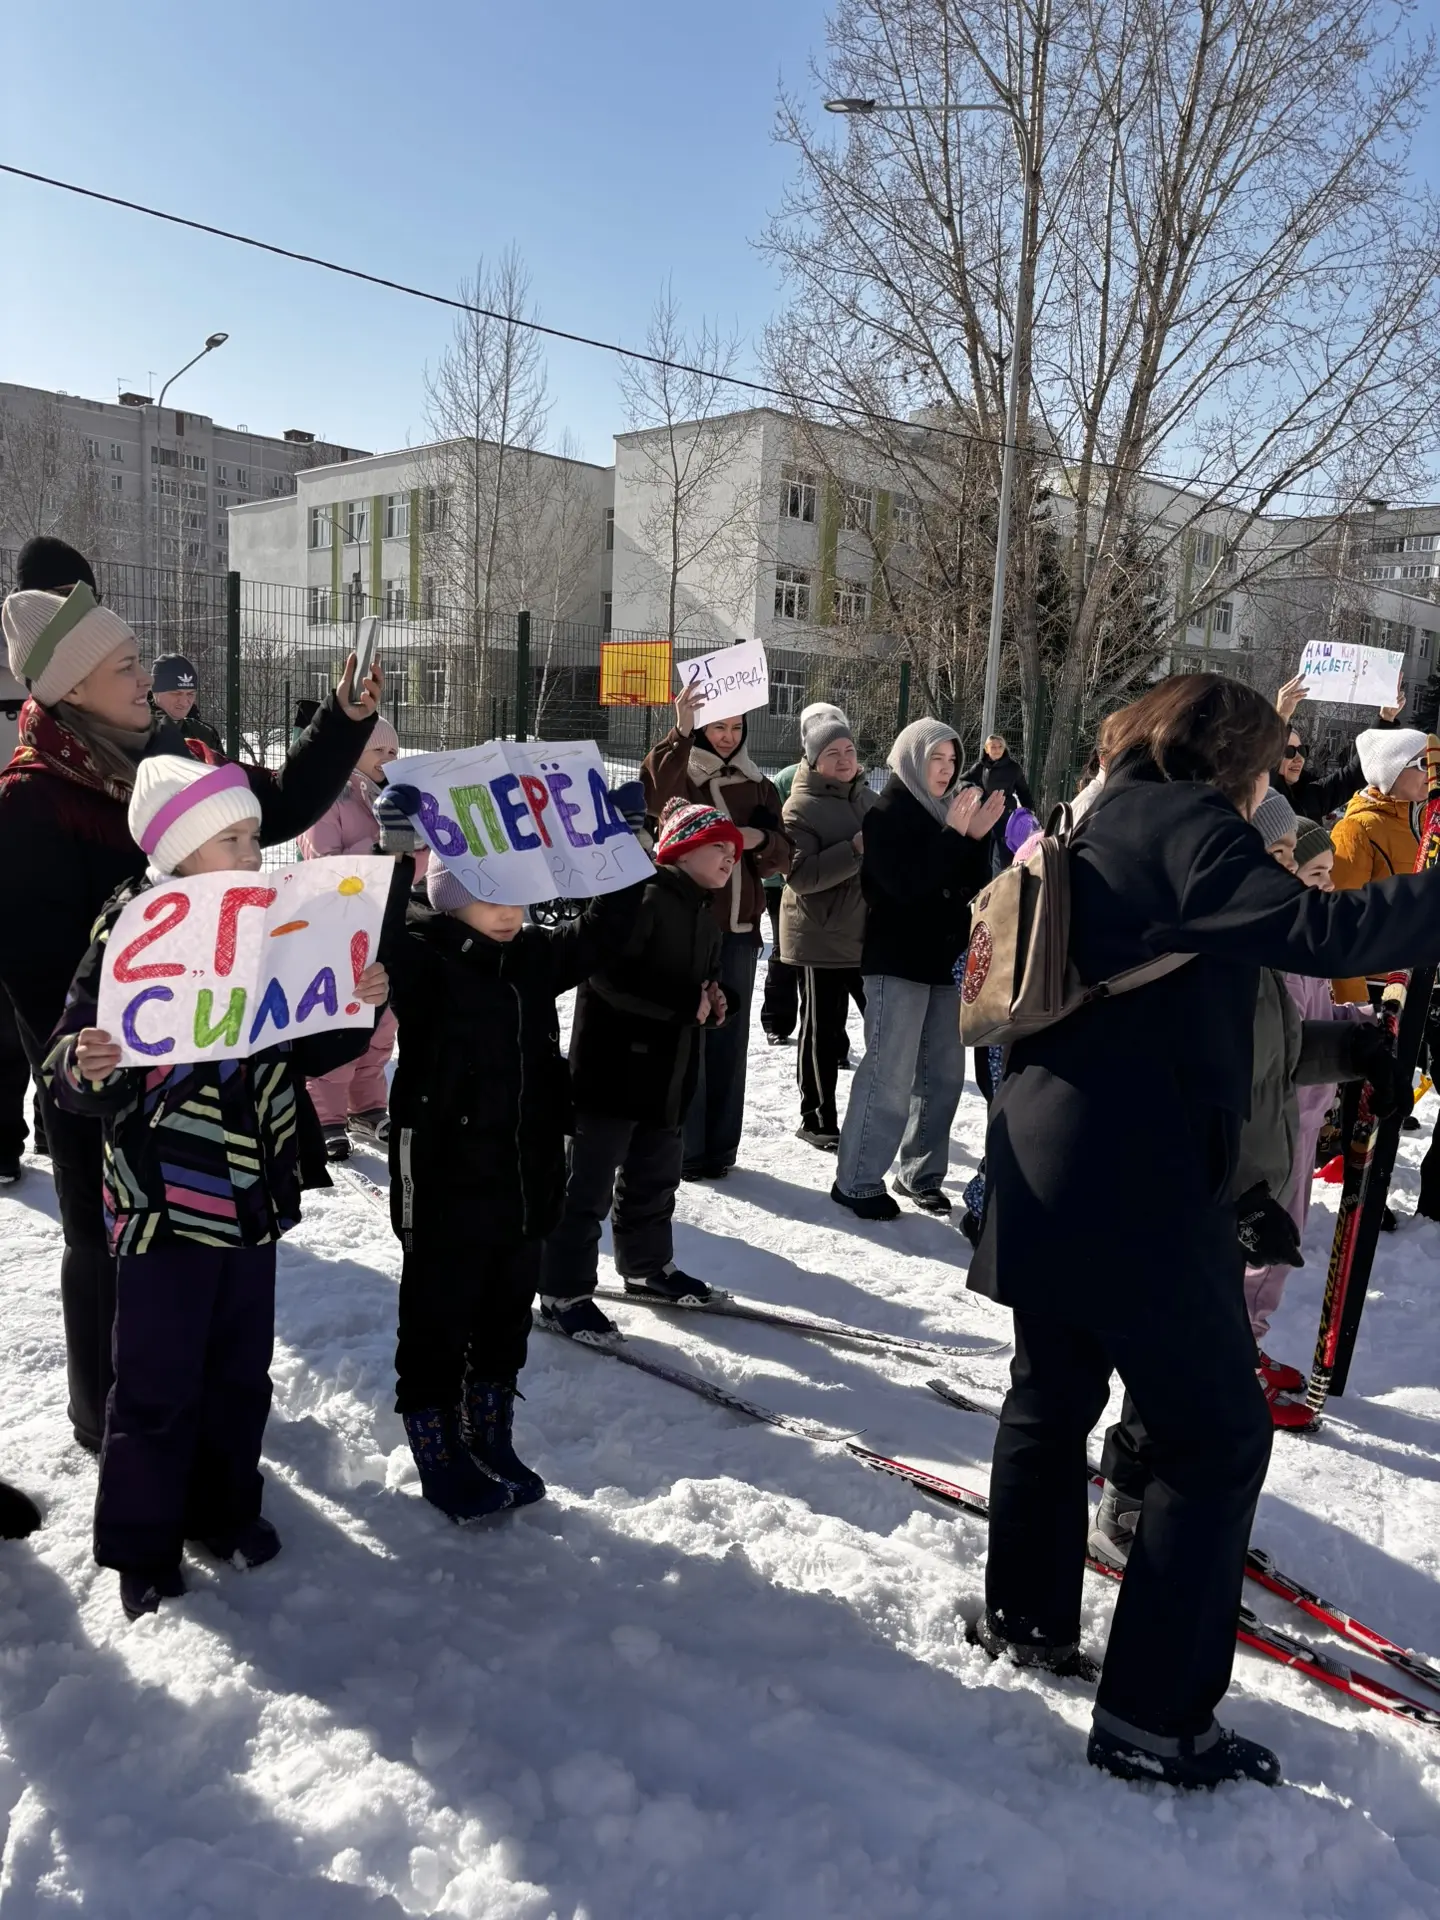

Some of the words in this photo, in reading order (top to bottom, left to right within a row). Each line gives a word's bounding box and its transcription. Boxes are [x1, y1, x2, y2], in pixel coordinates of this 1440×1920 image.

[688, 656, 716, 685] 2Г
[1305, 643, 1332, 658] НАШ
[417, 762, 633, 857] ВПЕРЁД
[121, 929, 370, 1056] СИЛА!
